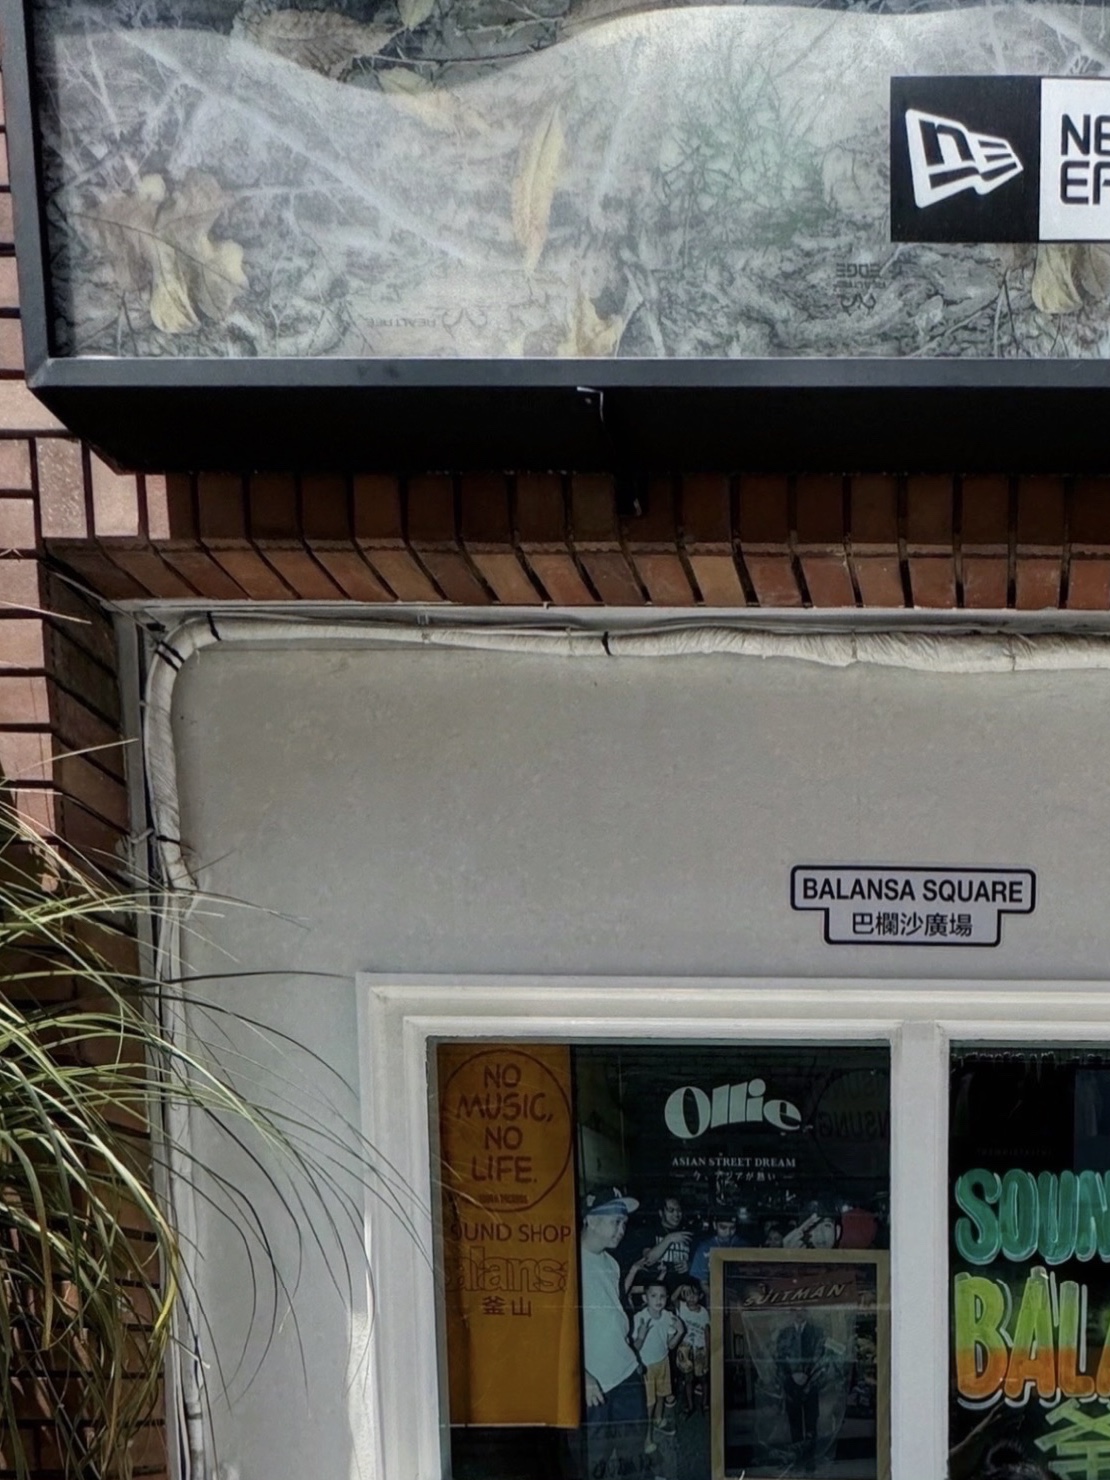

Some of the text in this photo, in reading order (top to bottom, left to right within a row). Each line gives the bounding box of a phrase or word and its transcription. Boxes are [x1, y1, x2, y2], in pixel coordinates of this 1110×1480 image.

[803, 877, 1023, 903] BALANSA SQUARE
[484, 1063, 521, 1089] NO
[455, 1092, 554, 1122] MUSIC,
[664, 1078, 802, 1139] Ollie
[485, 1126, 523, 1151] NO
[471, 1155, 538, 1183] LIFE.
[671, 1157, 797, 1168] ASIAN STREET DREAM
[519, 1223, 573, 1243] SHOP
[483, 1296, 532, 1318] 釜山
